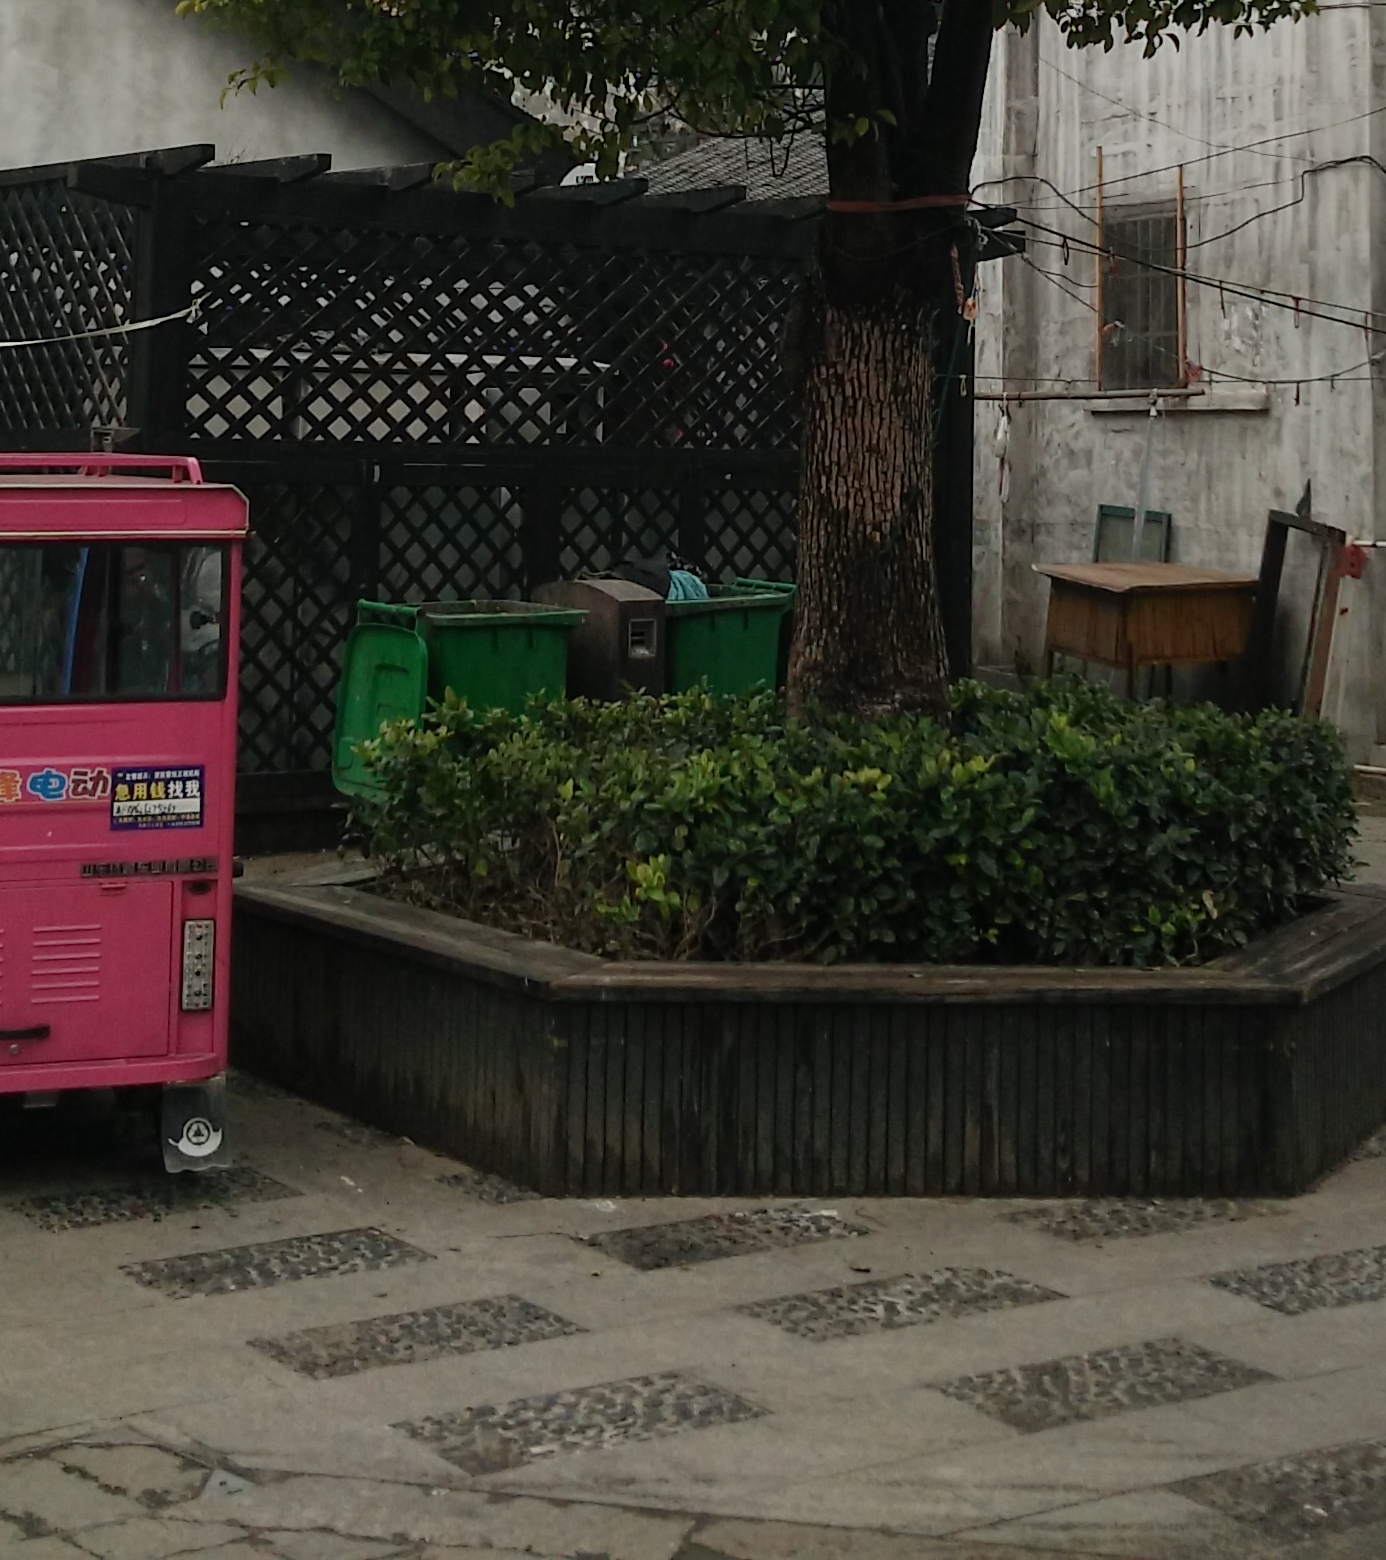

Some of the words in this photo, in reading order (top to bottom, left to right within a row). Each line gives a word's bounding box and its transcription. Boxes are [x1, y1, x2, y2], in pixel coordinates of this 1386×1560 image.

[114, 779, 201, 801] 急用钱找我
